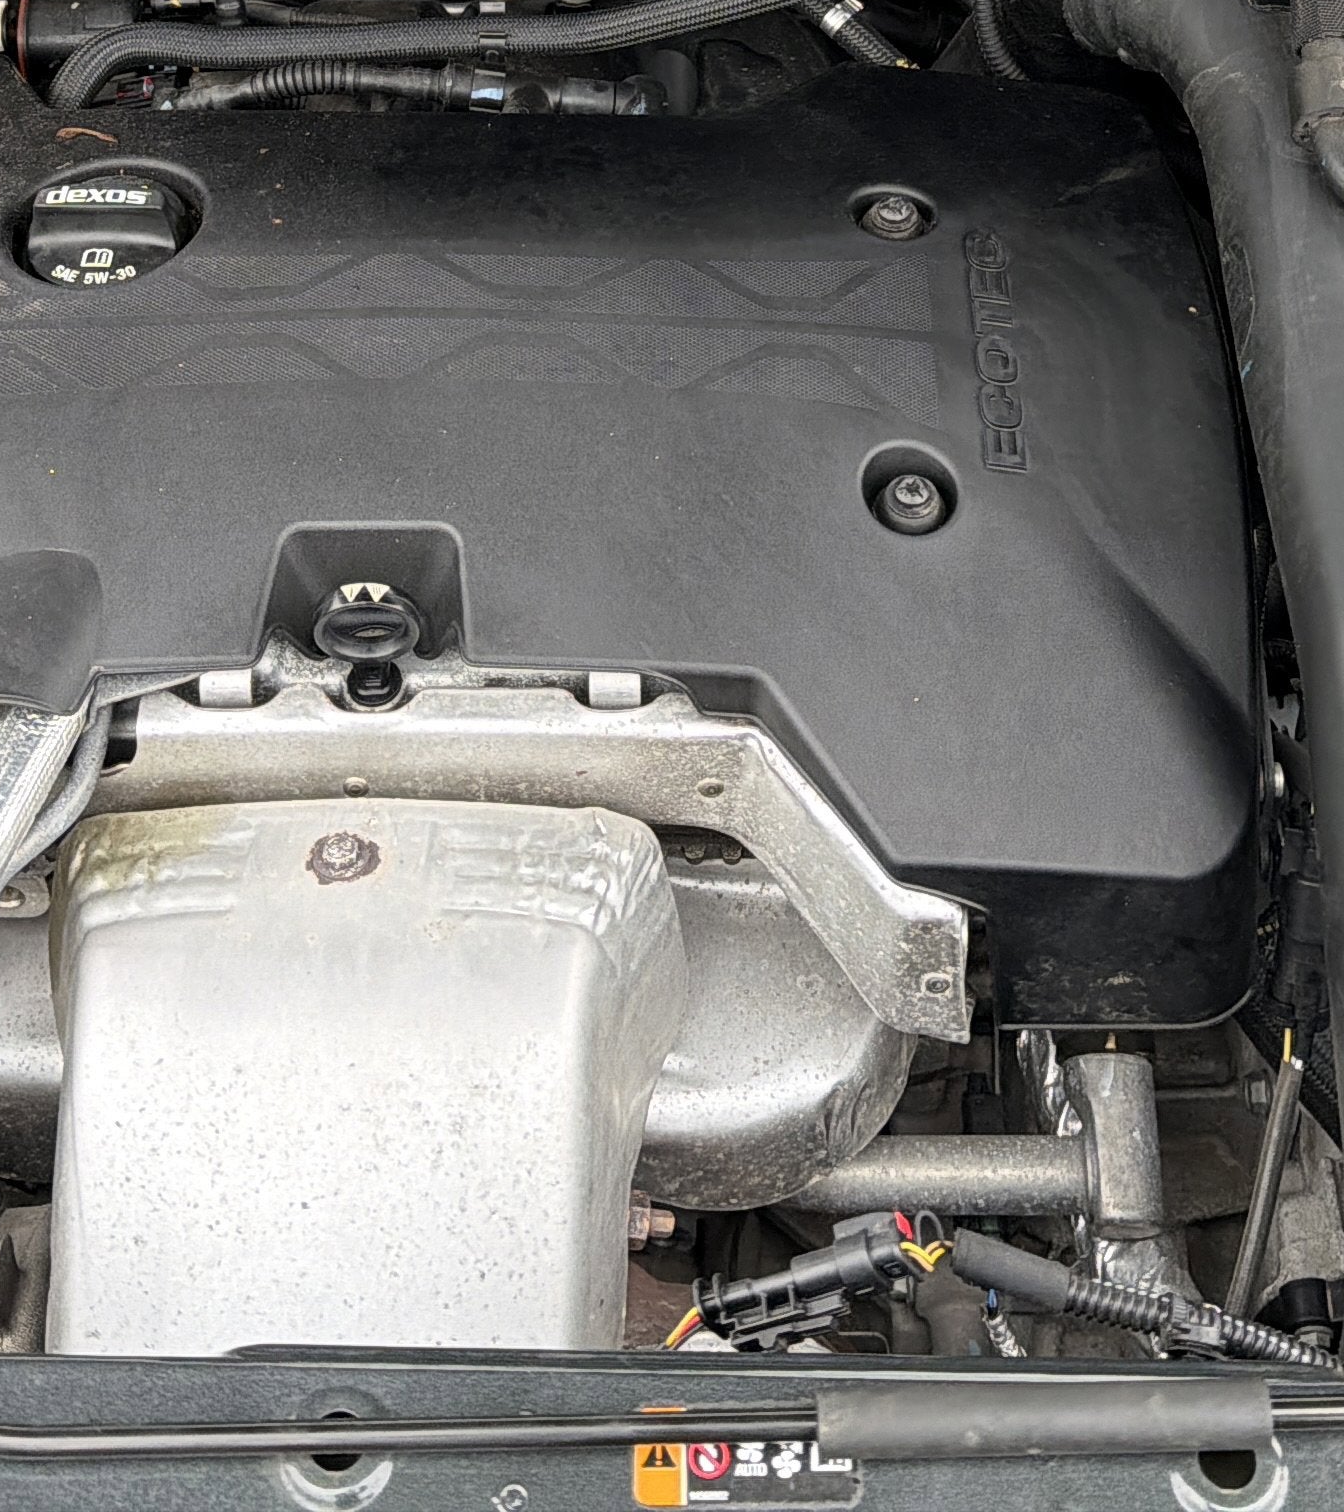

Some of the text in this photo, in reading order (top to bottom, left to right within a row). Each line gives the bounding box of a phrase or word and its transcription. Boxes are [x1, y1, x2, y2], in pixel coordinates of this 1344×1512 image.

[46, 185, 150, 205] dexos
[50, 264, 137, 285] SAE 5W-30
[964, 229, 1028, 474] ECOTEC
[734, 1462, 769, 1477] AUTO
